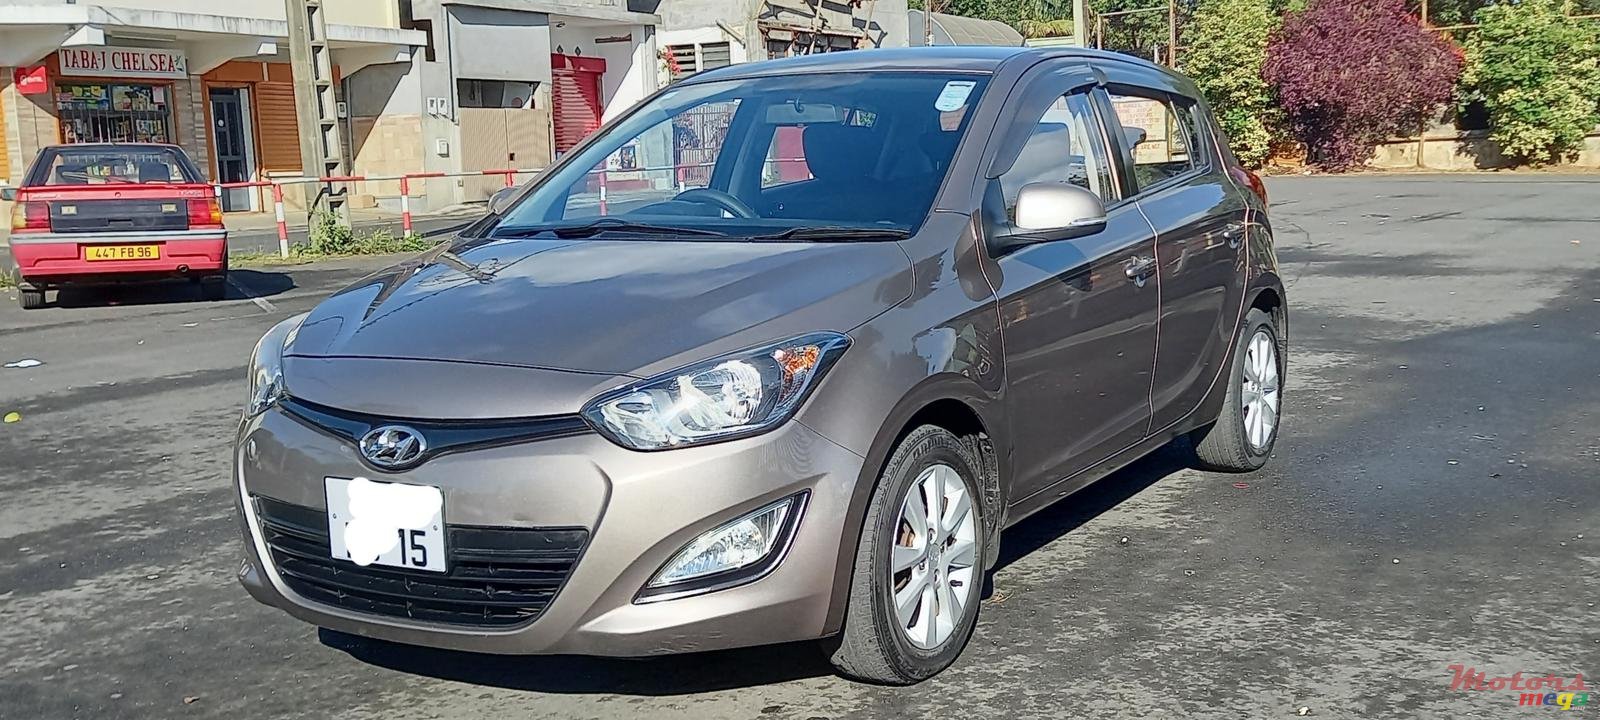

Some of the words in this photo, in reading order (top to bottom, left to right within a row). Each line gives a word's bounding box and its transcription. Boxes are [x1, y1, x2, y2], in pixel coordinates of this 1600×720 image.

[111, 51, 176, 72] CHELSEA
[95, 247, 116, 258] 447
[120, 247, 134, 257] FB
[138, 246, 152, 257] 96
[398, 528, 428, 567] 15
